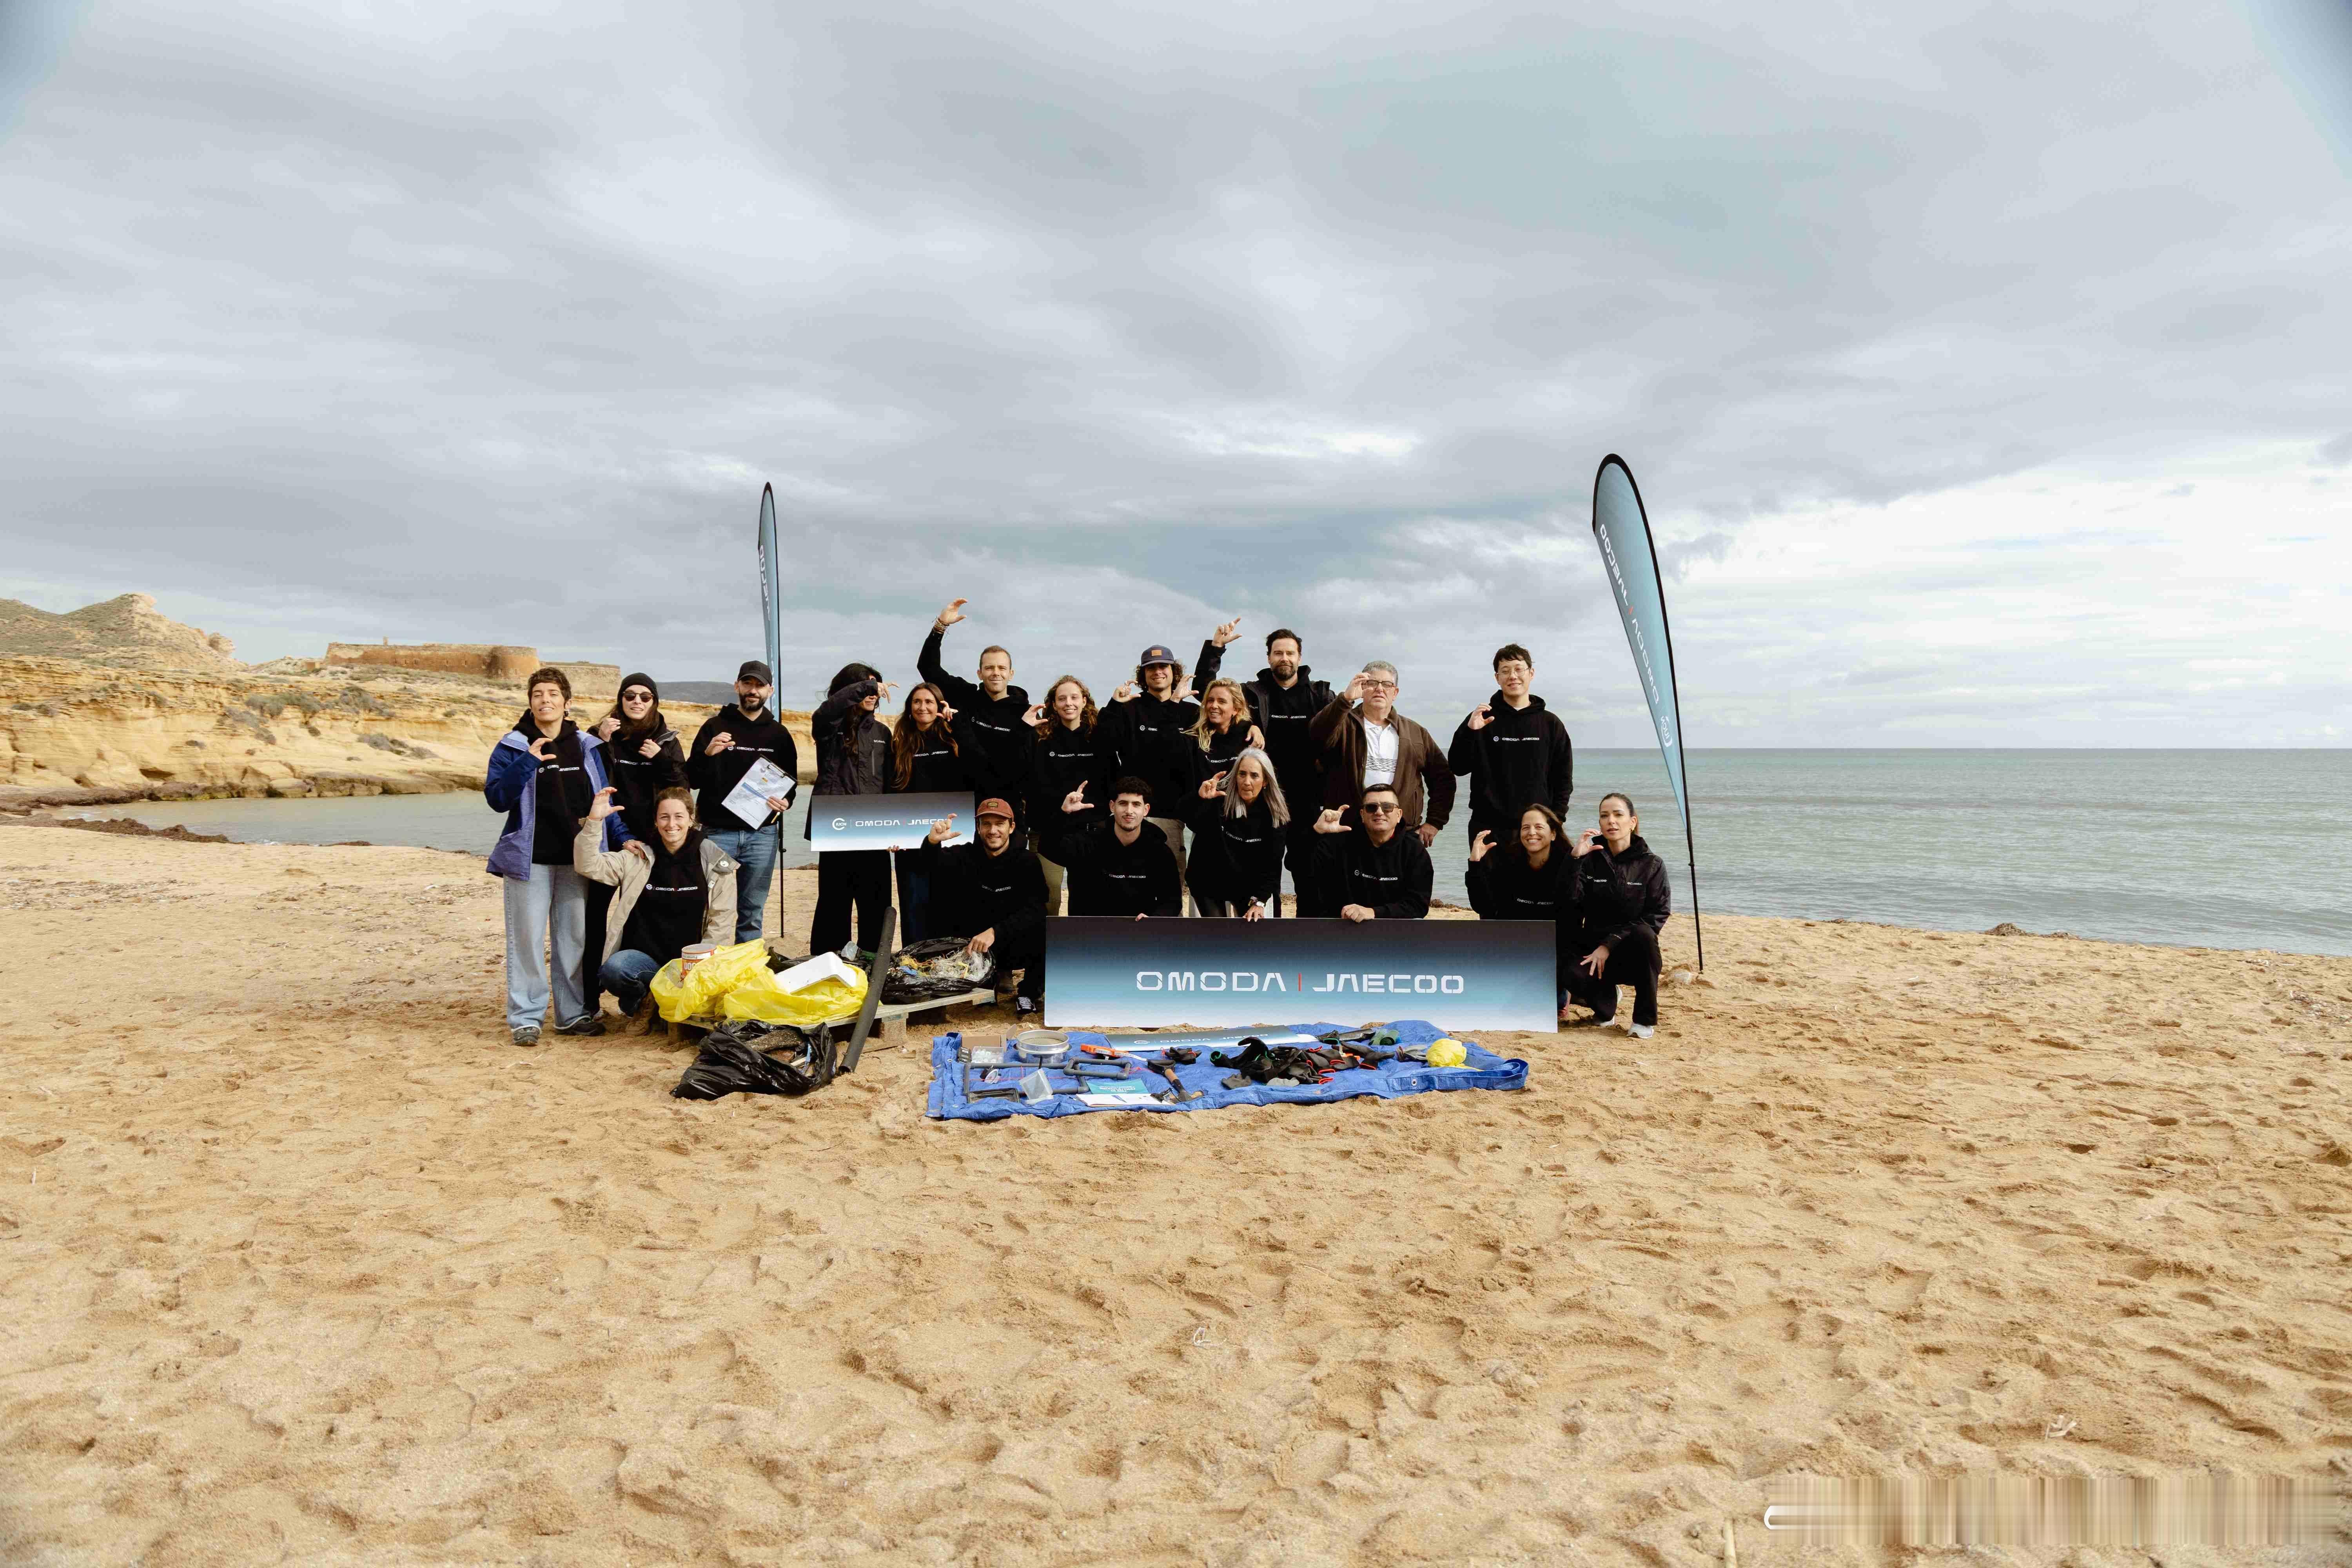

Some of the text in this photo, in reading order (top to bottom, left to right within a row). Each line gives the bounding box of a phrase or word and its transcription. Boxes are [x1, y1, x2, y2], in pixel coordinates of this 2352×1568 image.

[1601, 524, 1628, 606] JAECOO
[1632, 618, 1659, 704] OMODA
[1136, 971, 1464, 994] OMODA JAECOO
